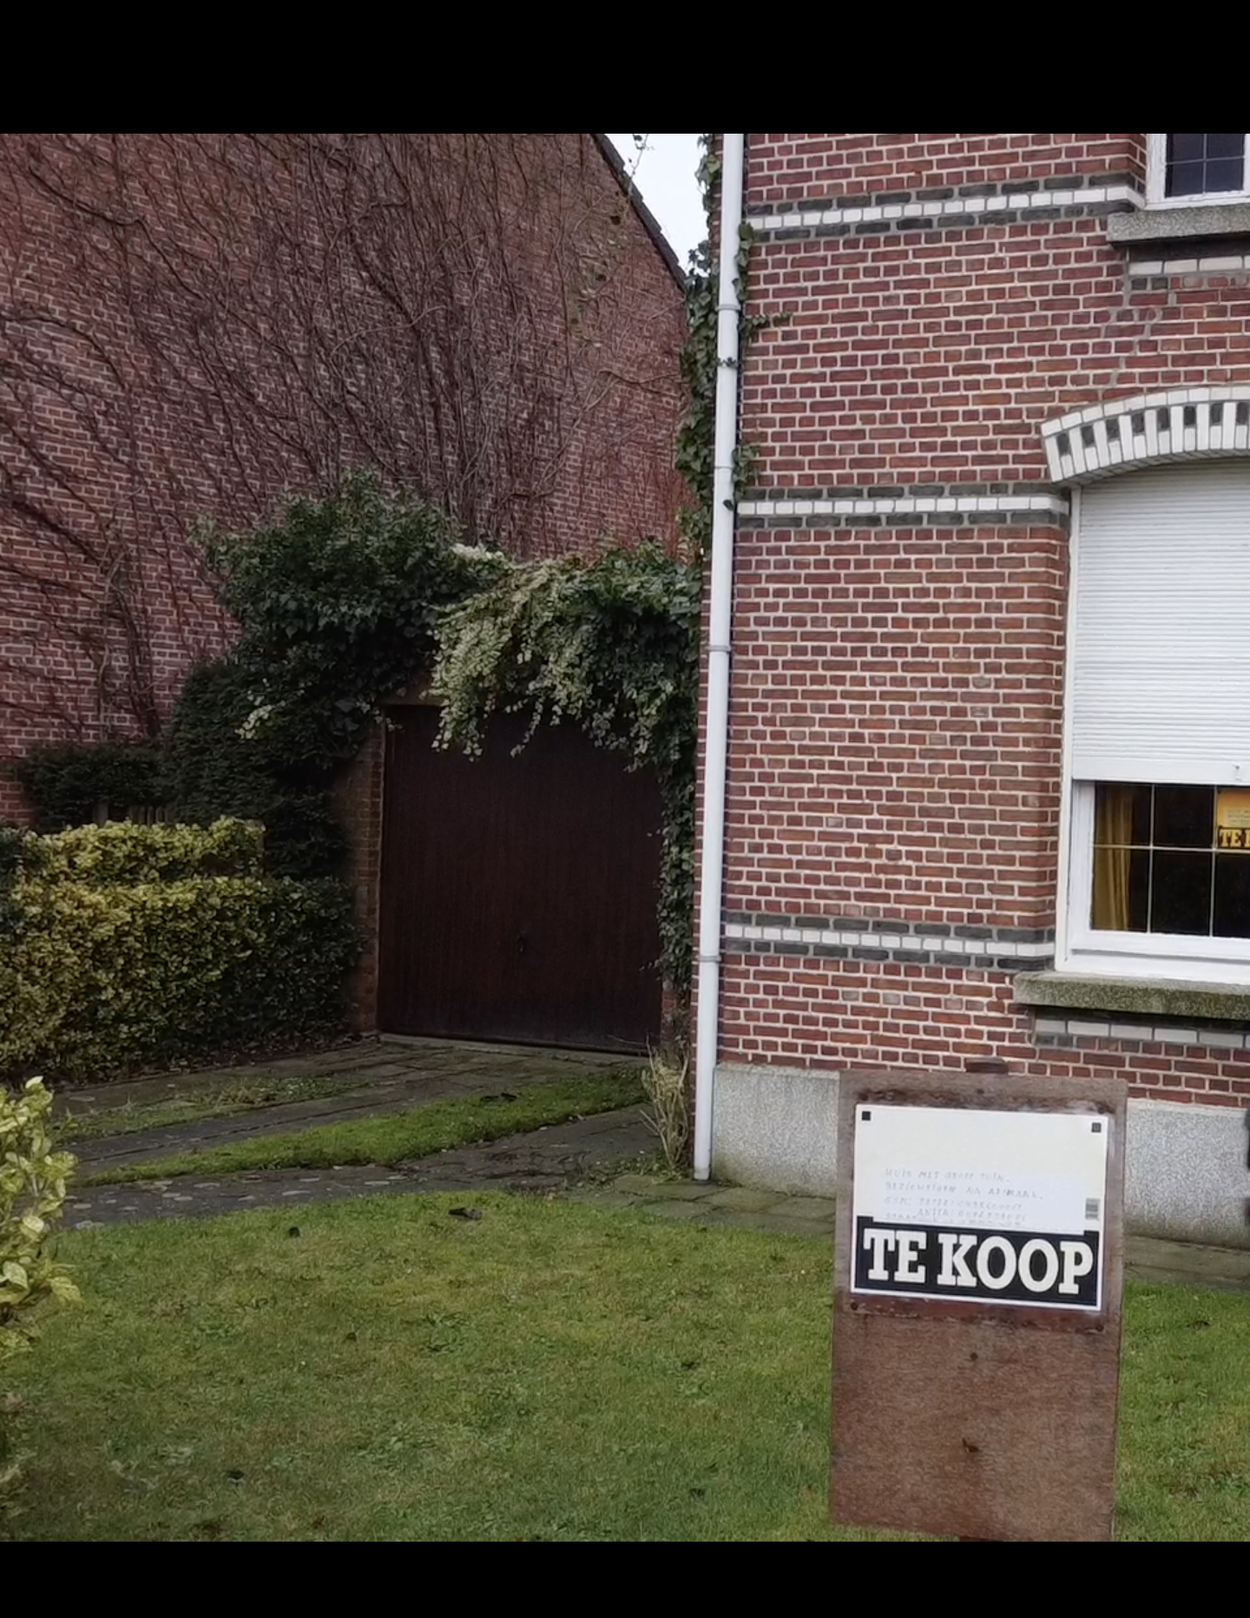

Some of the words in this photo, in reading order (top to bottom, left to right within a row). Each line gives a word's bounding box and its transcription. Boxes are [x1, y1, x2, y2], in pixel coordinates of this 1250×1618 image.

[1219, 829, 1242, 848] TE
[863, 1228, 927, 1284] TE
[937, 1233, 1094, 1295] KOOP
